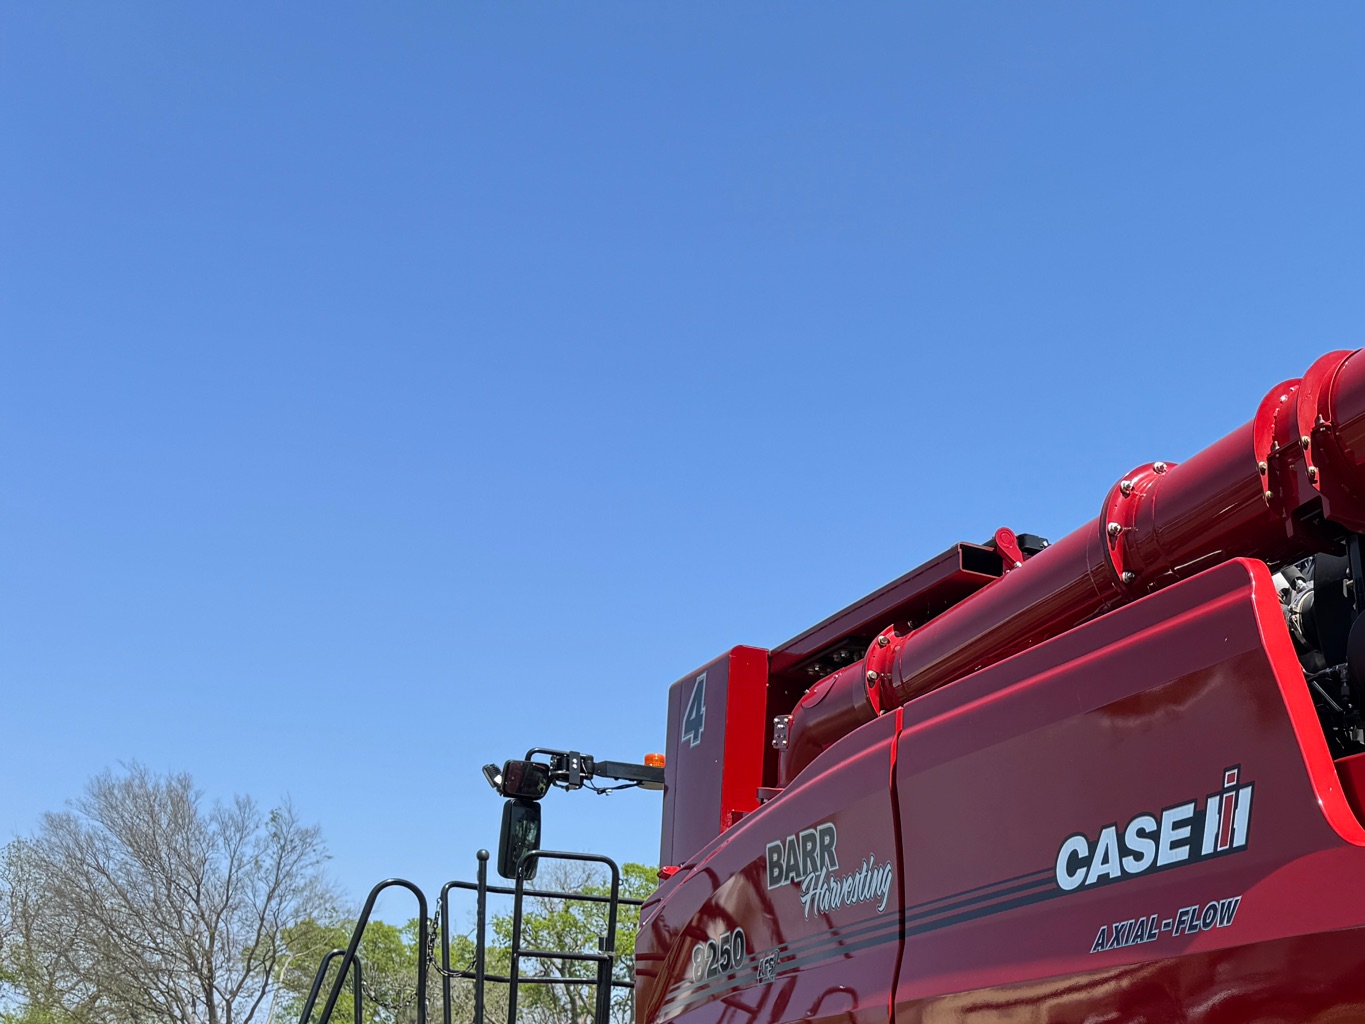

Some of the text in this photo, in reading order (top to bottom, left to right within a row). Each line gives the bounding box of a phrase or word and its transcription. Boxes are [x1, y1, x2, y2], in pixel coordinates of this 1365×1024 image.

[681, 670, 707, 748] 4
[765, 821, 839, 890] BARR
[1055, 801, 1196, 892] CASE
[800, 852, 893, 921] Harvesting
[691, 926, 746, 983] 8250
